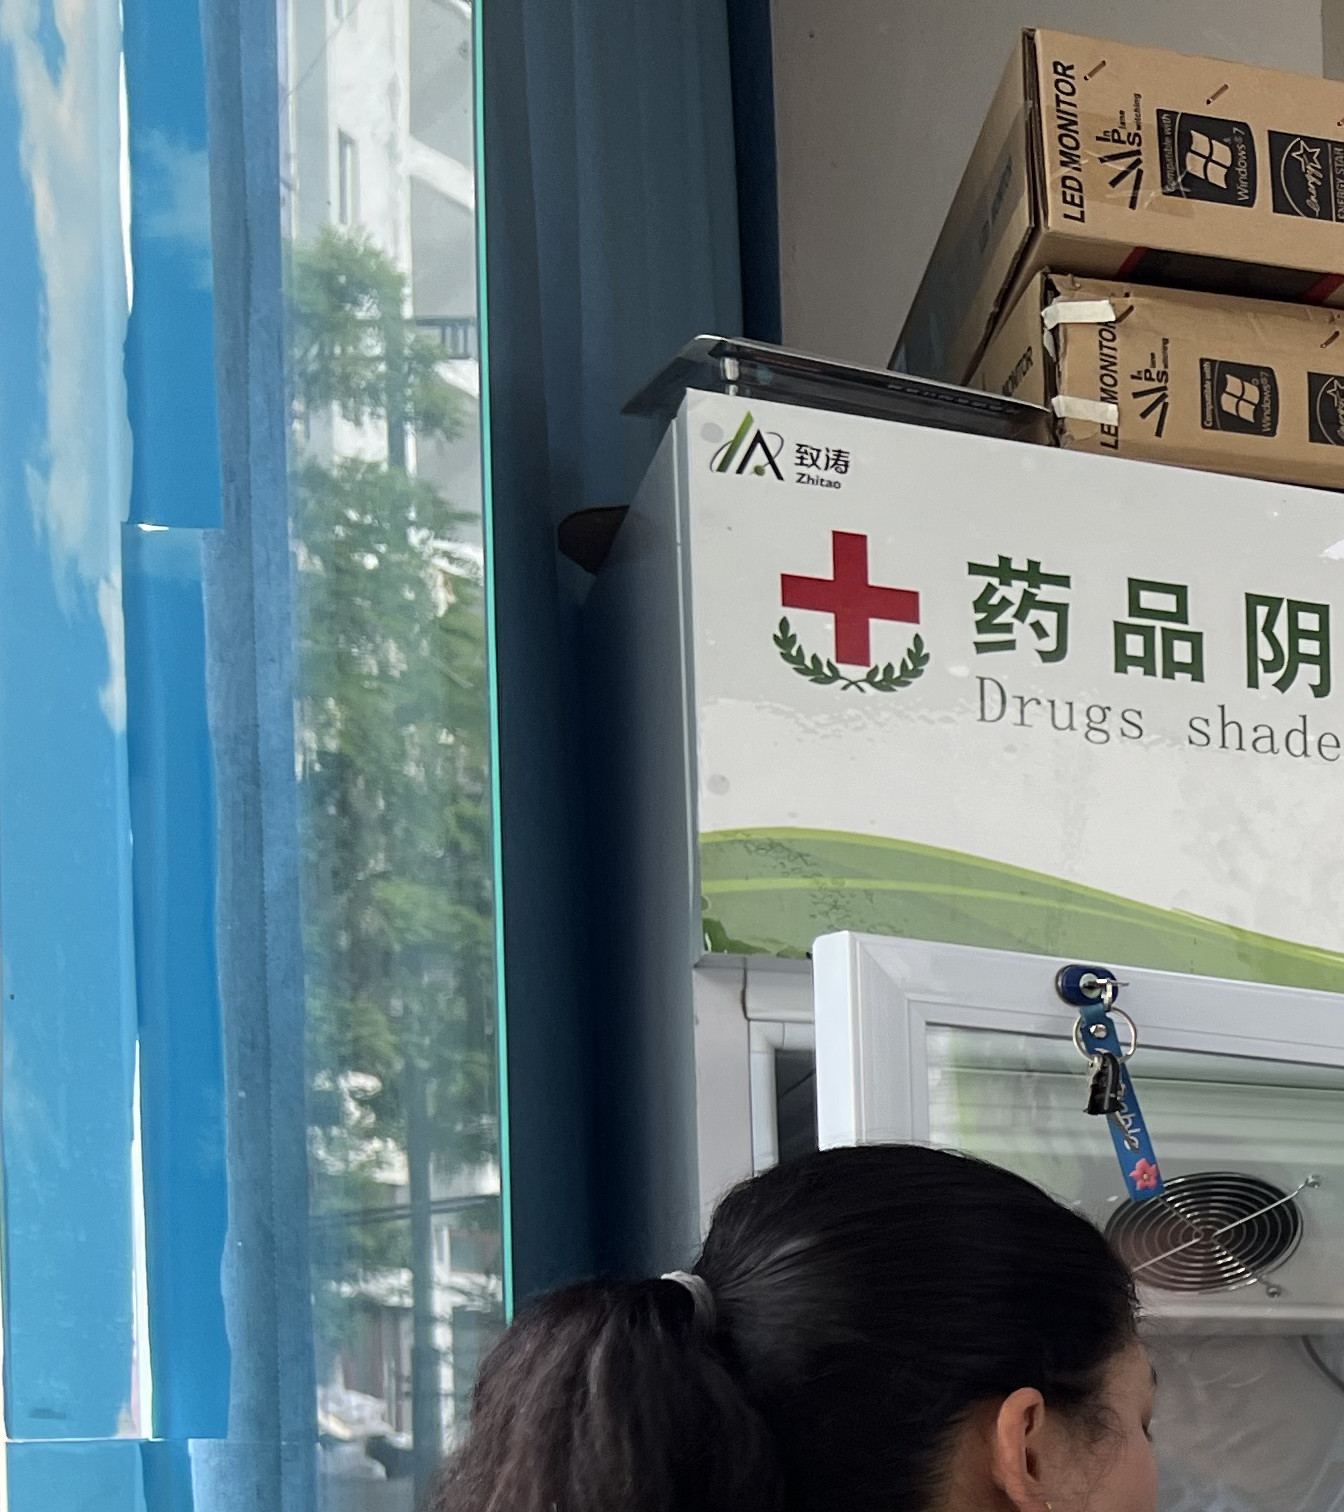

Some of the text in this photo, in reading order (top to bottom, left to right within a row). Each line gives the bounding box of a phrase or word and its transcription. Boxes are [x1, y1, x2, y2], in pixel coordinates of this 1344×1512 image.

[1052, 59, 1086, 224] LED MONITOR
[1100, 423, 1120, 450] LE
[794, 443, 852, 477] 致涛
[795, 471, 843, 491] Zhitao
[976, 675, 1145, 746] Drugs
[1187, 694, 1342, 764] shade
